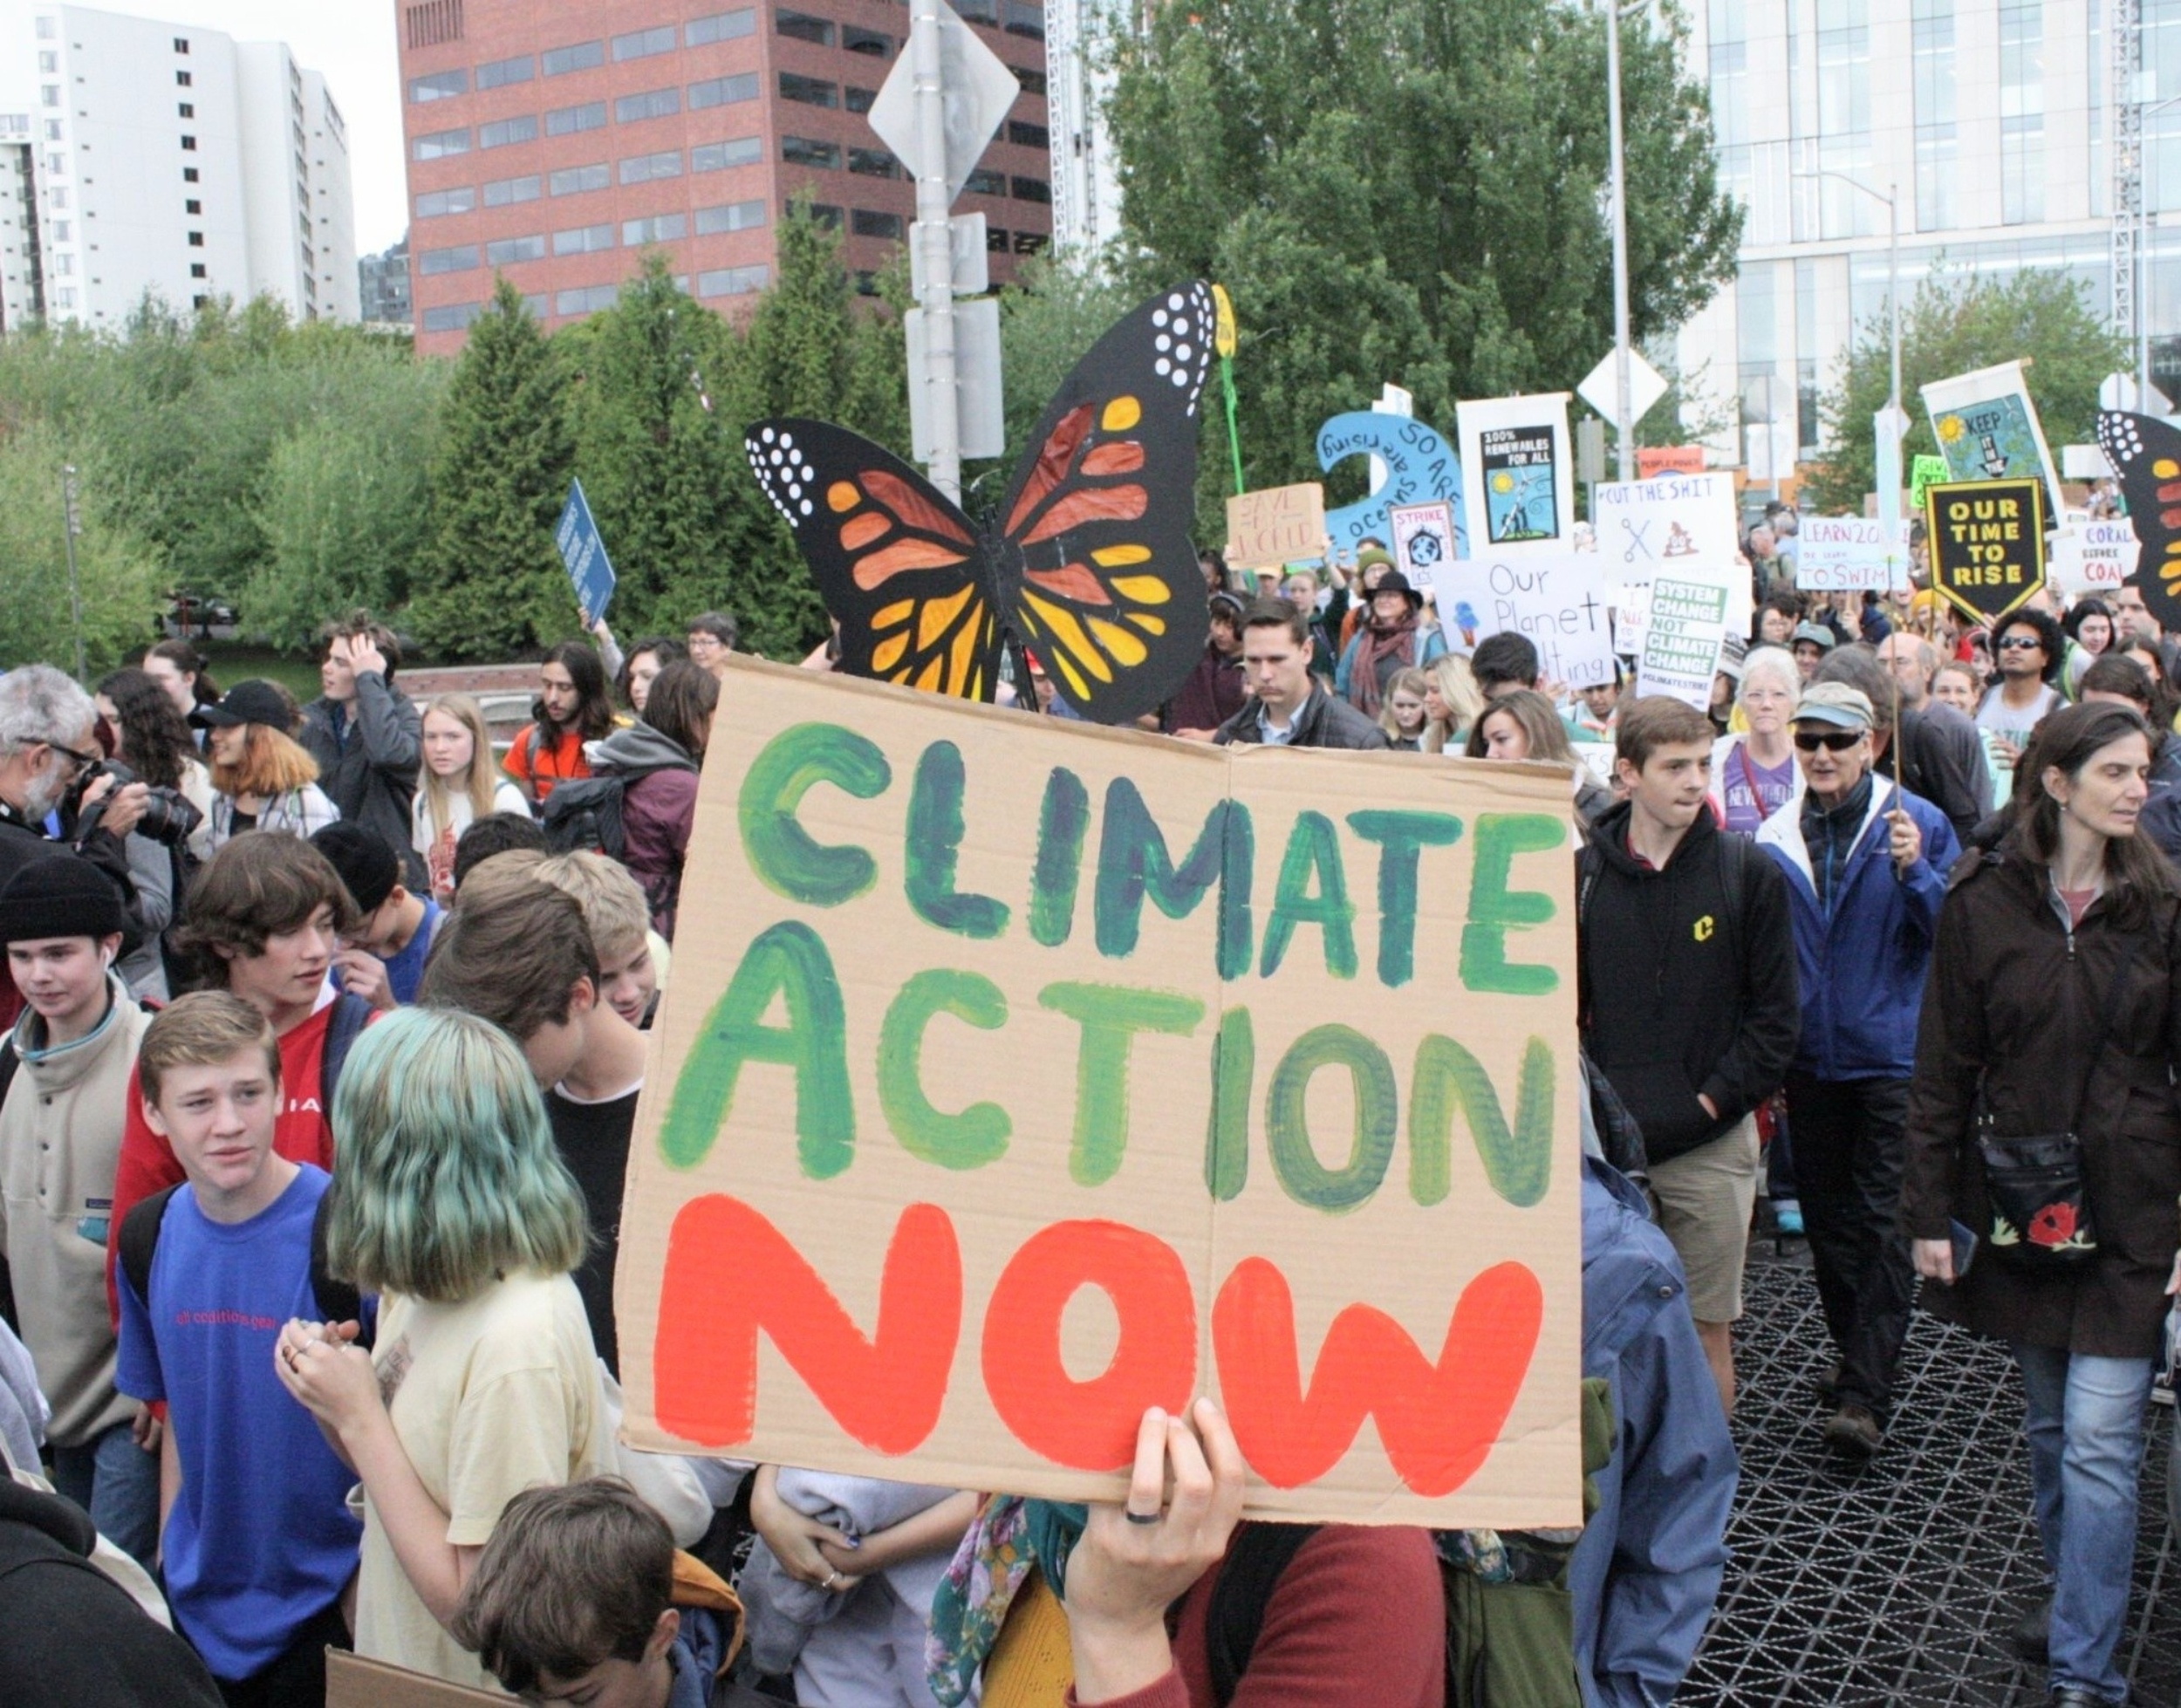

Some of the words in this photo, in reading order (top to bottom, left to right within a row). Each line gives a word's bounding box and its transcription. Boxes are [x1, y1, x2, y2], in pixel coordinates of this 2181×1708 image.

[1965, 411, 2001, 435] KEEP
[1398, 422, 1438, 454] SO
[1484, 429, 1516, 443] 100%
[1485, 438, 1550, 456] RENEWABLES
[1507, 453, 1528, 466] FOR
[1531, 450, 1551, 464] ALL
[1635, 482, 1666, 502] THE
[1670, 477, 1713, 500] SHIT
[1397, 509, 1445, 525] STRIKE
[1949, 498, 2020, 522] OUR
[1949, 521, 2020, 543] TIME
[2085, 525, 2131, 544] CORAL
[1966, 543, 2006, 564] TO
[2082, 548, 2119, 559] BEFORE
[1489, 563, 1549, 596] Our
[1800, 566, 1830, 586] TO
[1833, 563, 1886, 587] SWIM
[1952, 564, 2022, 586] RISE
[2084, 563, 2124, 583] COAL
[1655, 579, 1720, 604] SYSTEM
[1494, 590, 1601, 635] Planet
[1651, 598, 1721, 623] CHANGE
[1651, 616, 1687, 635] NOT
[1647, 632, 1718, 658] CLIMATE
[1541, 639, 1605, 684] lting
[1644, 651, 1713, 675] CHANGE
[1642, 672, 1709, 692] #CLIMATESTRIKE
[737, 721, 1569, 996] CLIMATE
[656, 919, 1558, 1214] ACTION
[653, 1192, 1544, 1500] NOW
